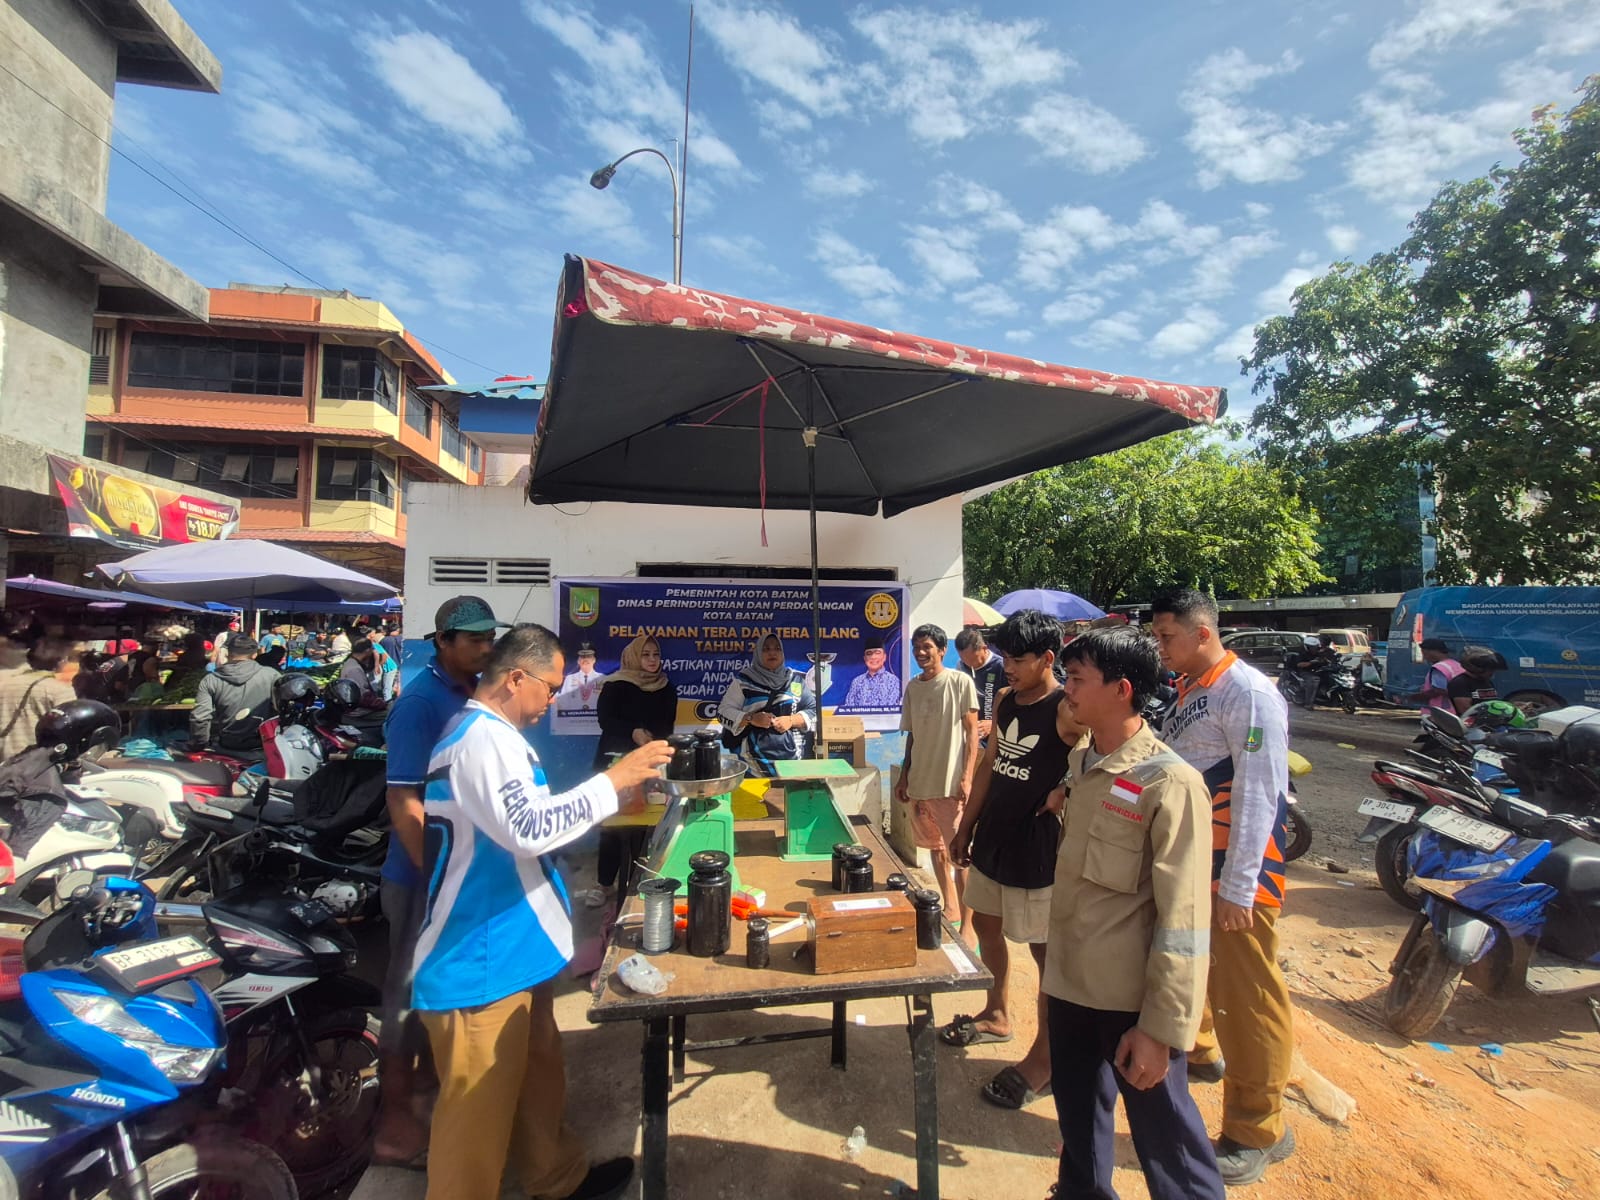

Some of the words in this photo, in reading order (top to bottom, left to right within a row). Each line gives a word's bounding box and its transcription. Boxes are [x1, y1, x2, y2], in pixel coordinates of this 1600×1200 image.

[666, 588, 737, 598] PEMERINTAH
[740, 590, 768, 599] KOTA
[771, 591, 809, 599] BATAM
[617, 599, 653, 608] DINAS
[655, 600, 744, 609] PERINDUSTRIAN
[746, 601, 771, 610] DAN
[703, 611, 732, 620] KOTA
[736, 612, 774, 620] BATAM
[609, 625, 698, 638] PELAYANAN
[702, 626, 738, 639] TERA
[741, 627, 773, 639] DAN
[775, 627, 809, 639] TERA
[695, 640, 744, 653] TAHUN
[661, 659, 713, 671] ASTIKAN
[702, 671, 735, 683] ANDA
[676, 684, 715, 696] SUDAH
[1431, 802, 1448, 817] BP
[111, 953, 134, 969] BP
[71, 1087, 126, 1107] HONDA
